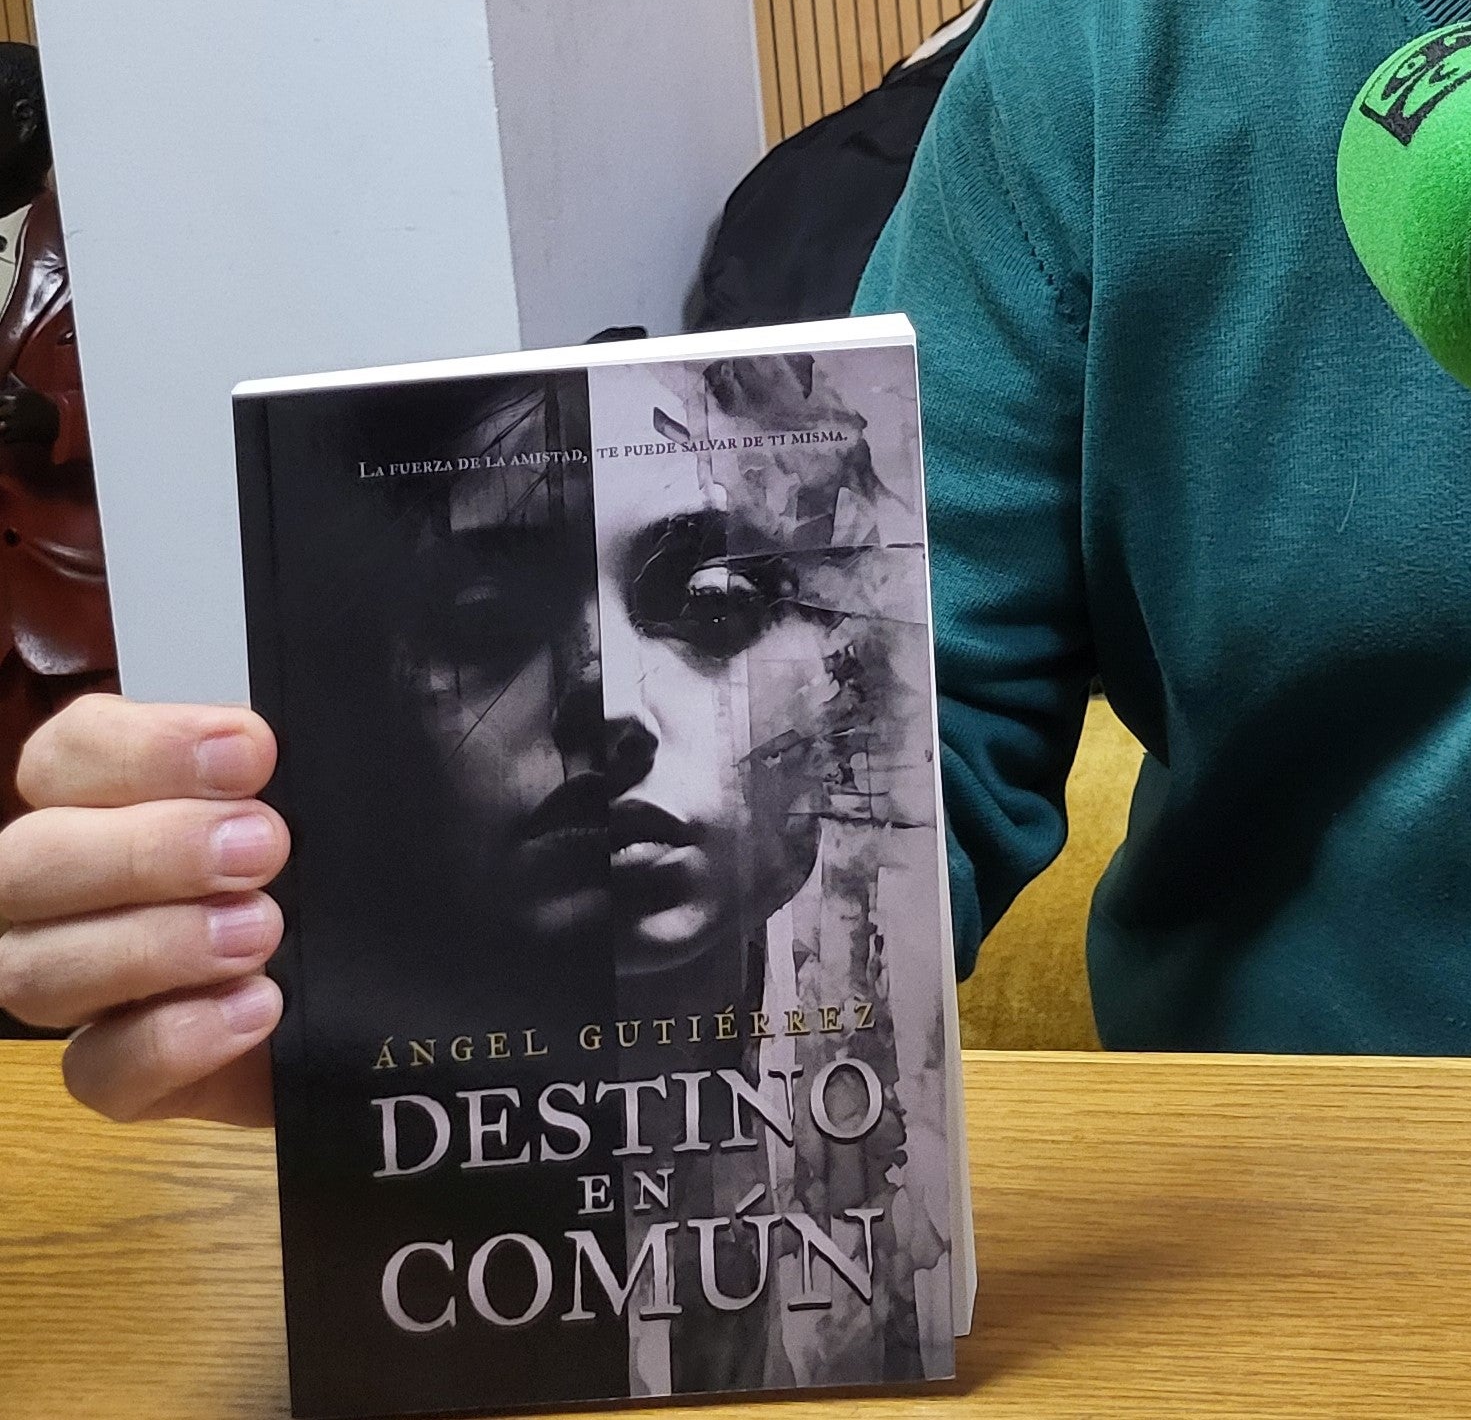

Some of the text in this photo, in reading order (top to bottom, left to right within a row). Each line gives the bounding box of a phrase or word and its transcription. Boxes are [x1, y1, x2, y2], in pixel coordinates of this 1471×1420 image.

[358, 430, 849, 479] LA FUERZA DE LA AMISTAD, TE PUEDE SALVAR DE TI MISMA.
[372, 1000, 877, 1070] ÁNGEL GUTIÉRREZ
[370, 1054, 884, 1179] DESTINO
[577, 1167, 676, 1215] EN
[380, 1182, 886, 1334] COMÚN
